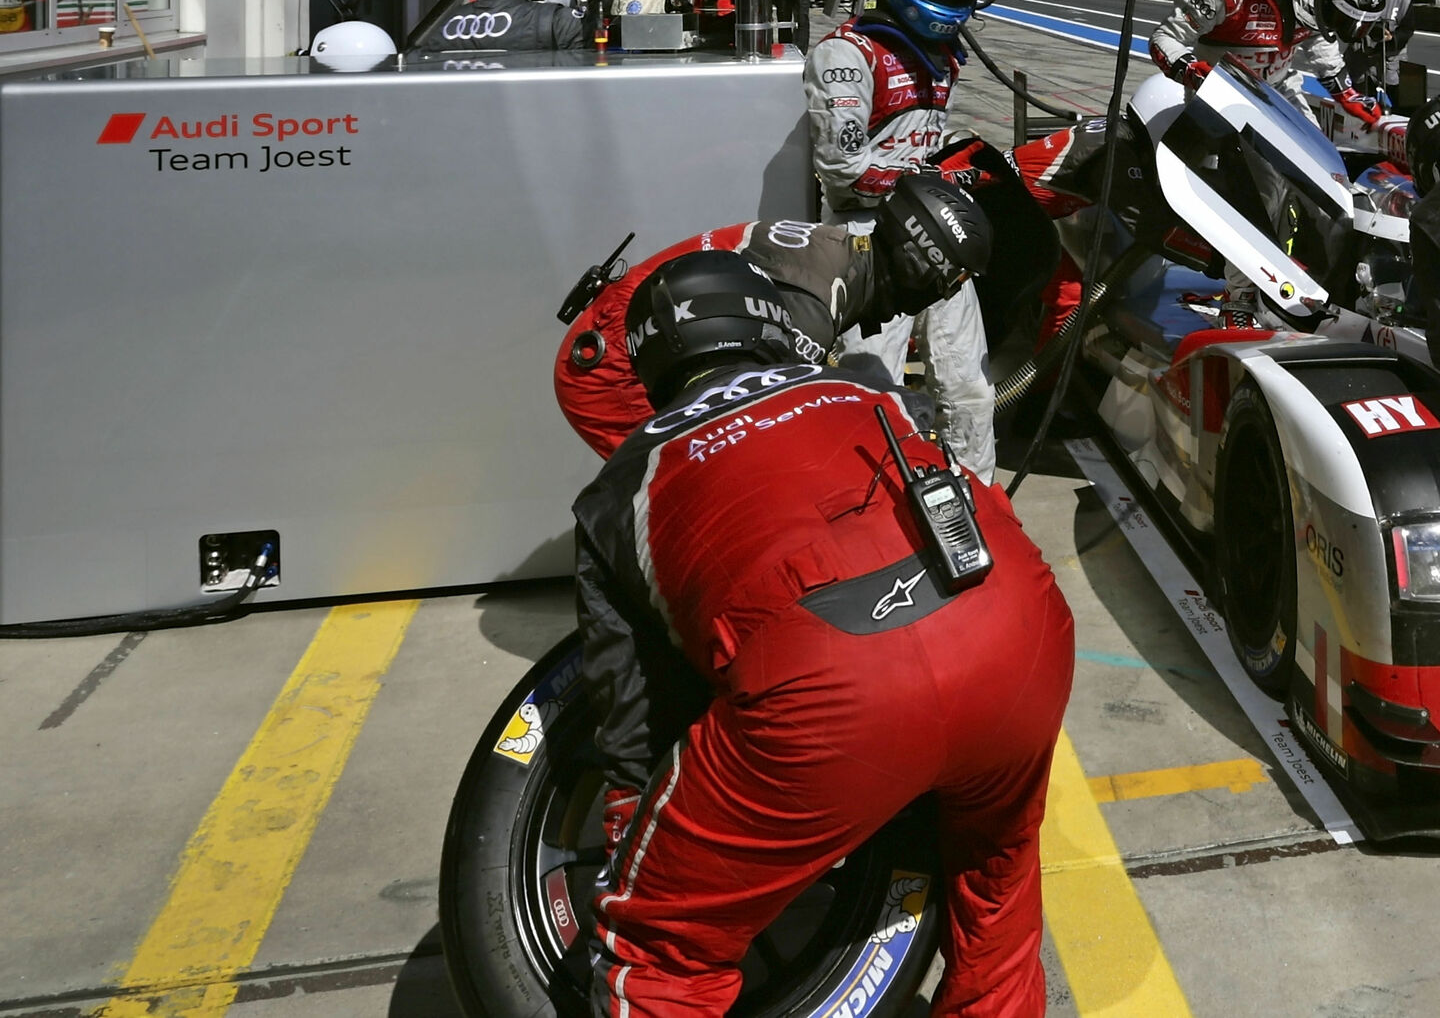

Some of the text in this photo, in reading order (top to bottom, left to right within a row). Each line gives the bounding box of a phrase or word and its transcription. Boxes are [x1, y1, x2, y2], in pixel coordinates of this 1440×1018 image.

[1249, 3, 1272, 14] ORI
[150, 113, 359, 142] Audi Sport
[149, 146, 352, 172] Team Joest
[940, 206, 968, 244] uvex
[904, 215, 954, 276] uvex
[744, 296, 792, 329] uve
[689, 395, 862, 463] Top Service
[1346, 396, 1426, 435] HY
[688, 415, 753, 456] Audi
[1306, 524, 1344, 577] ORIS
[1178, 598, 1208, 635] Team Joest
[1203, 611, 1223, 632] Sport
[1271, 731, 1315, 785] Team Joest
[1306, 720, 1347, 768] MICHELIN
[494, 915, 511, 960] RADIAL
